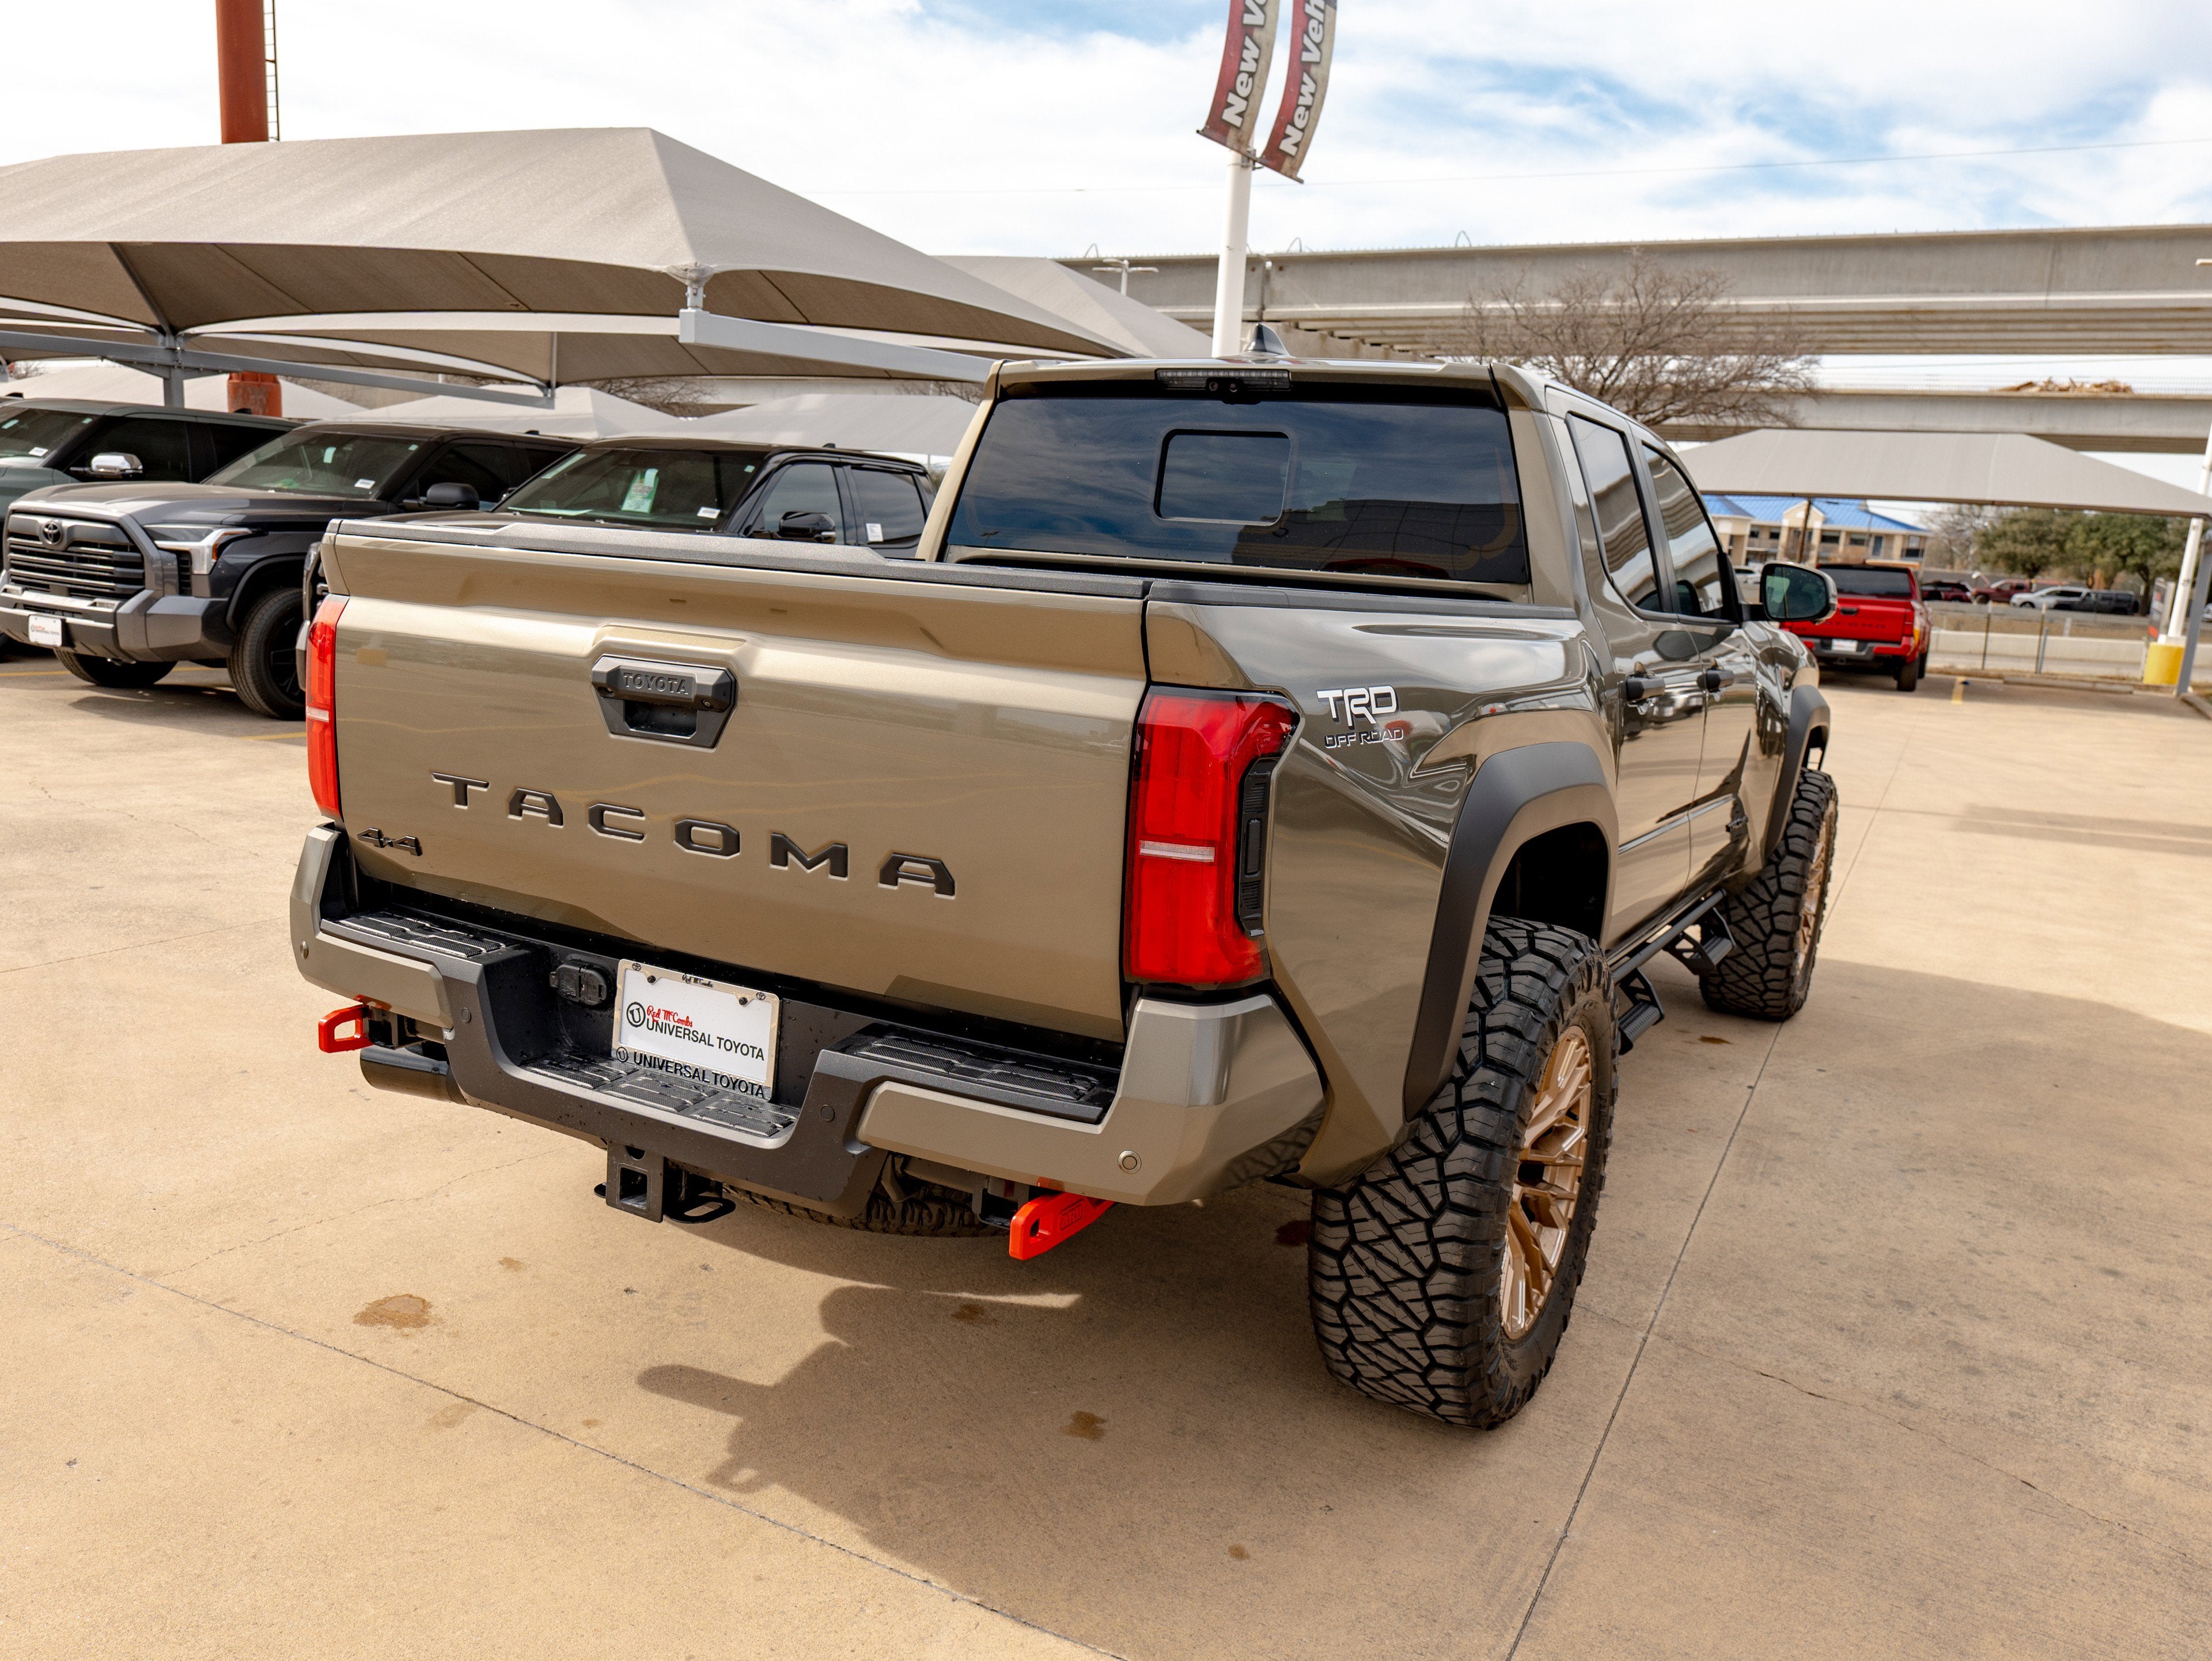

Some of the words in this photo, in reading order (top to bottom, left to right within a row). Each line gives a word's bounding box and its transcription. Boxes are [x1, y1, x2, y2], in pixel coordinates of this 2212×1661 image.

[1221, 35, 1260, 128] New
[1243, 0, 1267, 27] V
[1278, 71, 1317, 157] New
[623, 672, 688, 695] TOYOTA
[1316, 684, 1400, 731] TRD
[1324, 732, 1357, 749] OFF
[1358, 727, 1404, 745] ROAD
[431, 770, 956, 899] TACOMA
[646, 1018, 714, 1047] UNIVERSAL
[716, 1036, 765, 1061] TOYOTA
[647, 1005, 661, 1022] Red
[662, 1009, 693, 1027] McCombs
[634, 1050, 710, 1083] UNIVERSAL
[711, 1070, 765, 1099] TOYOTA
